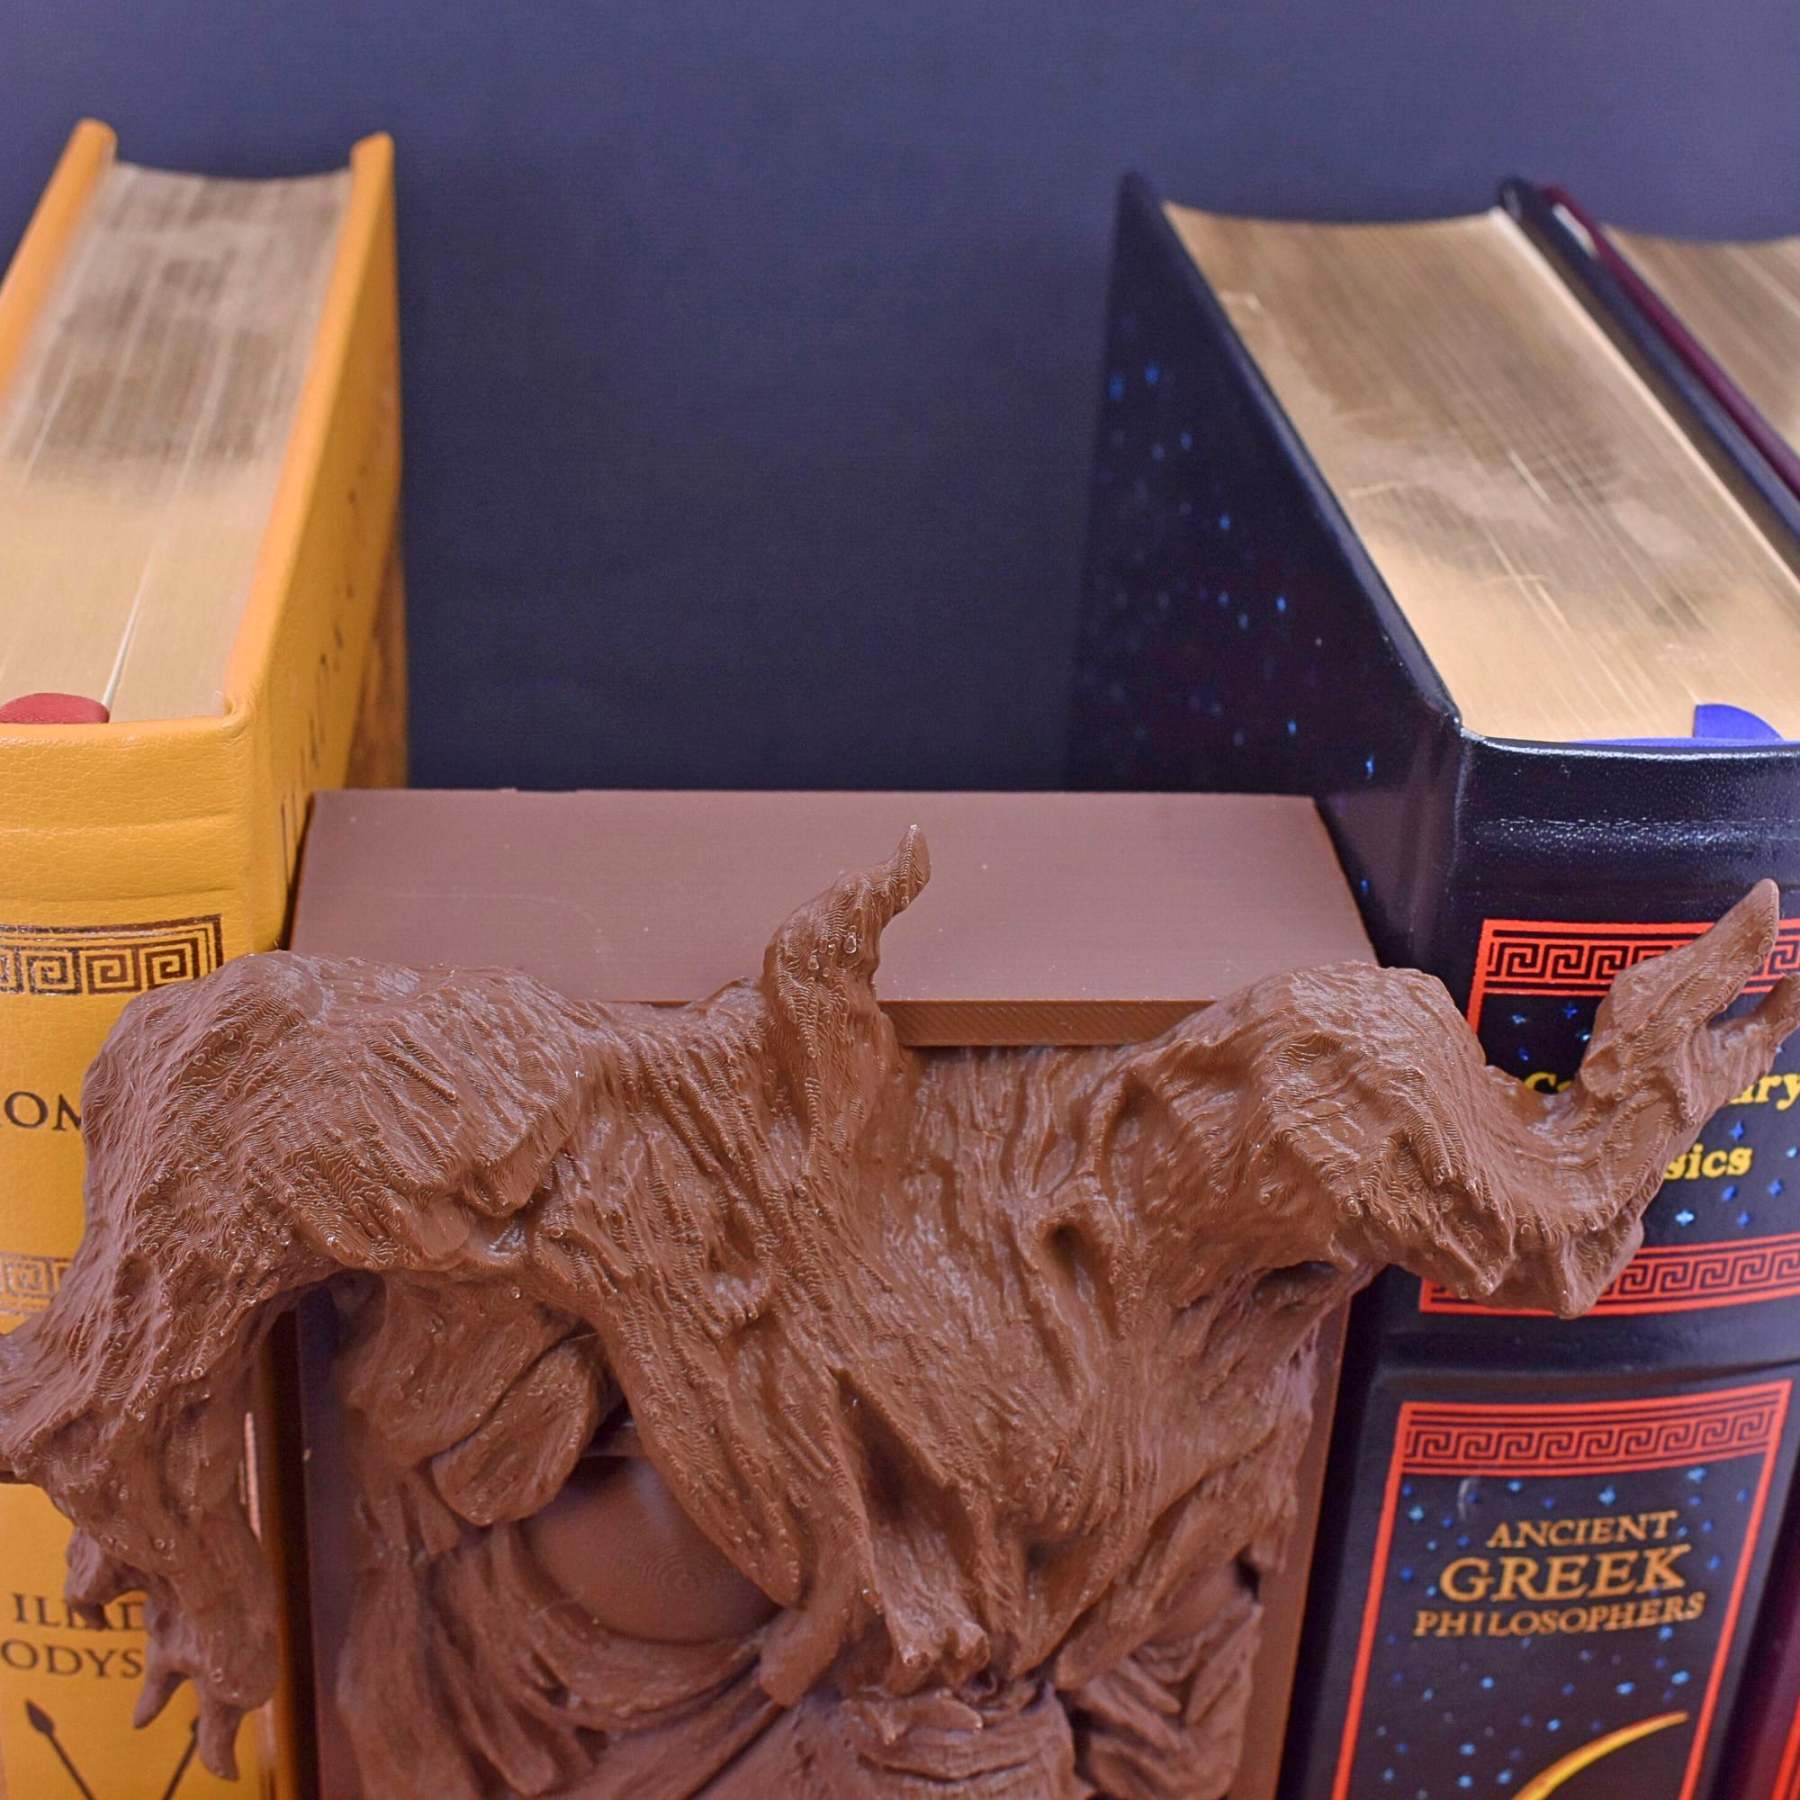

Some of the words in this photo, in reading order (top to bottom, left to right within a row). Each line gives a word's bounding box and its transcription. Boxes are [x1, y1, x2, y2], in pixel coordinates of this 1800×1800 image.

[1486, 1511, 1678, 1547] ANCIENT
[1440, 1544, 1692, 1602] GREEK
[1413, 1593, 1706, 1637] PHILOSOPHERS
[0, 1637, 144, 1679] ODYS
